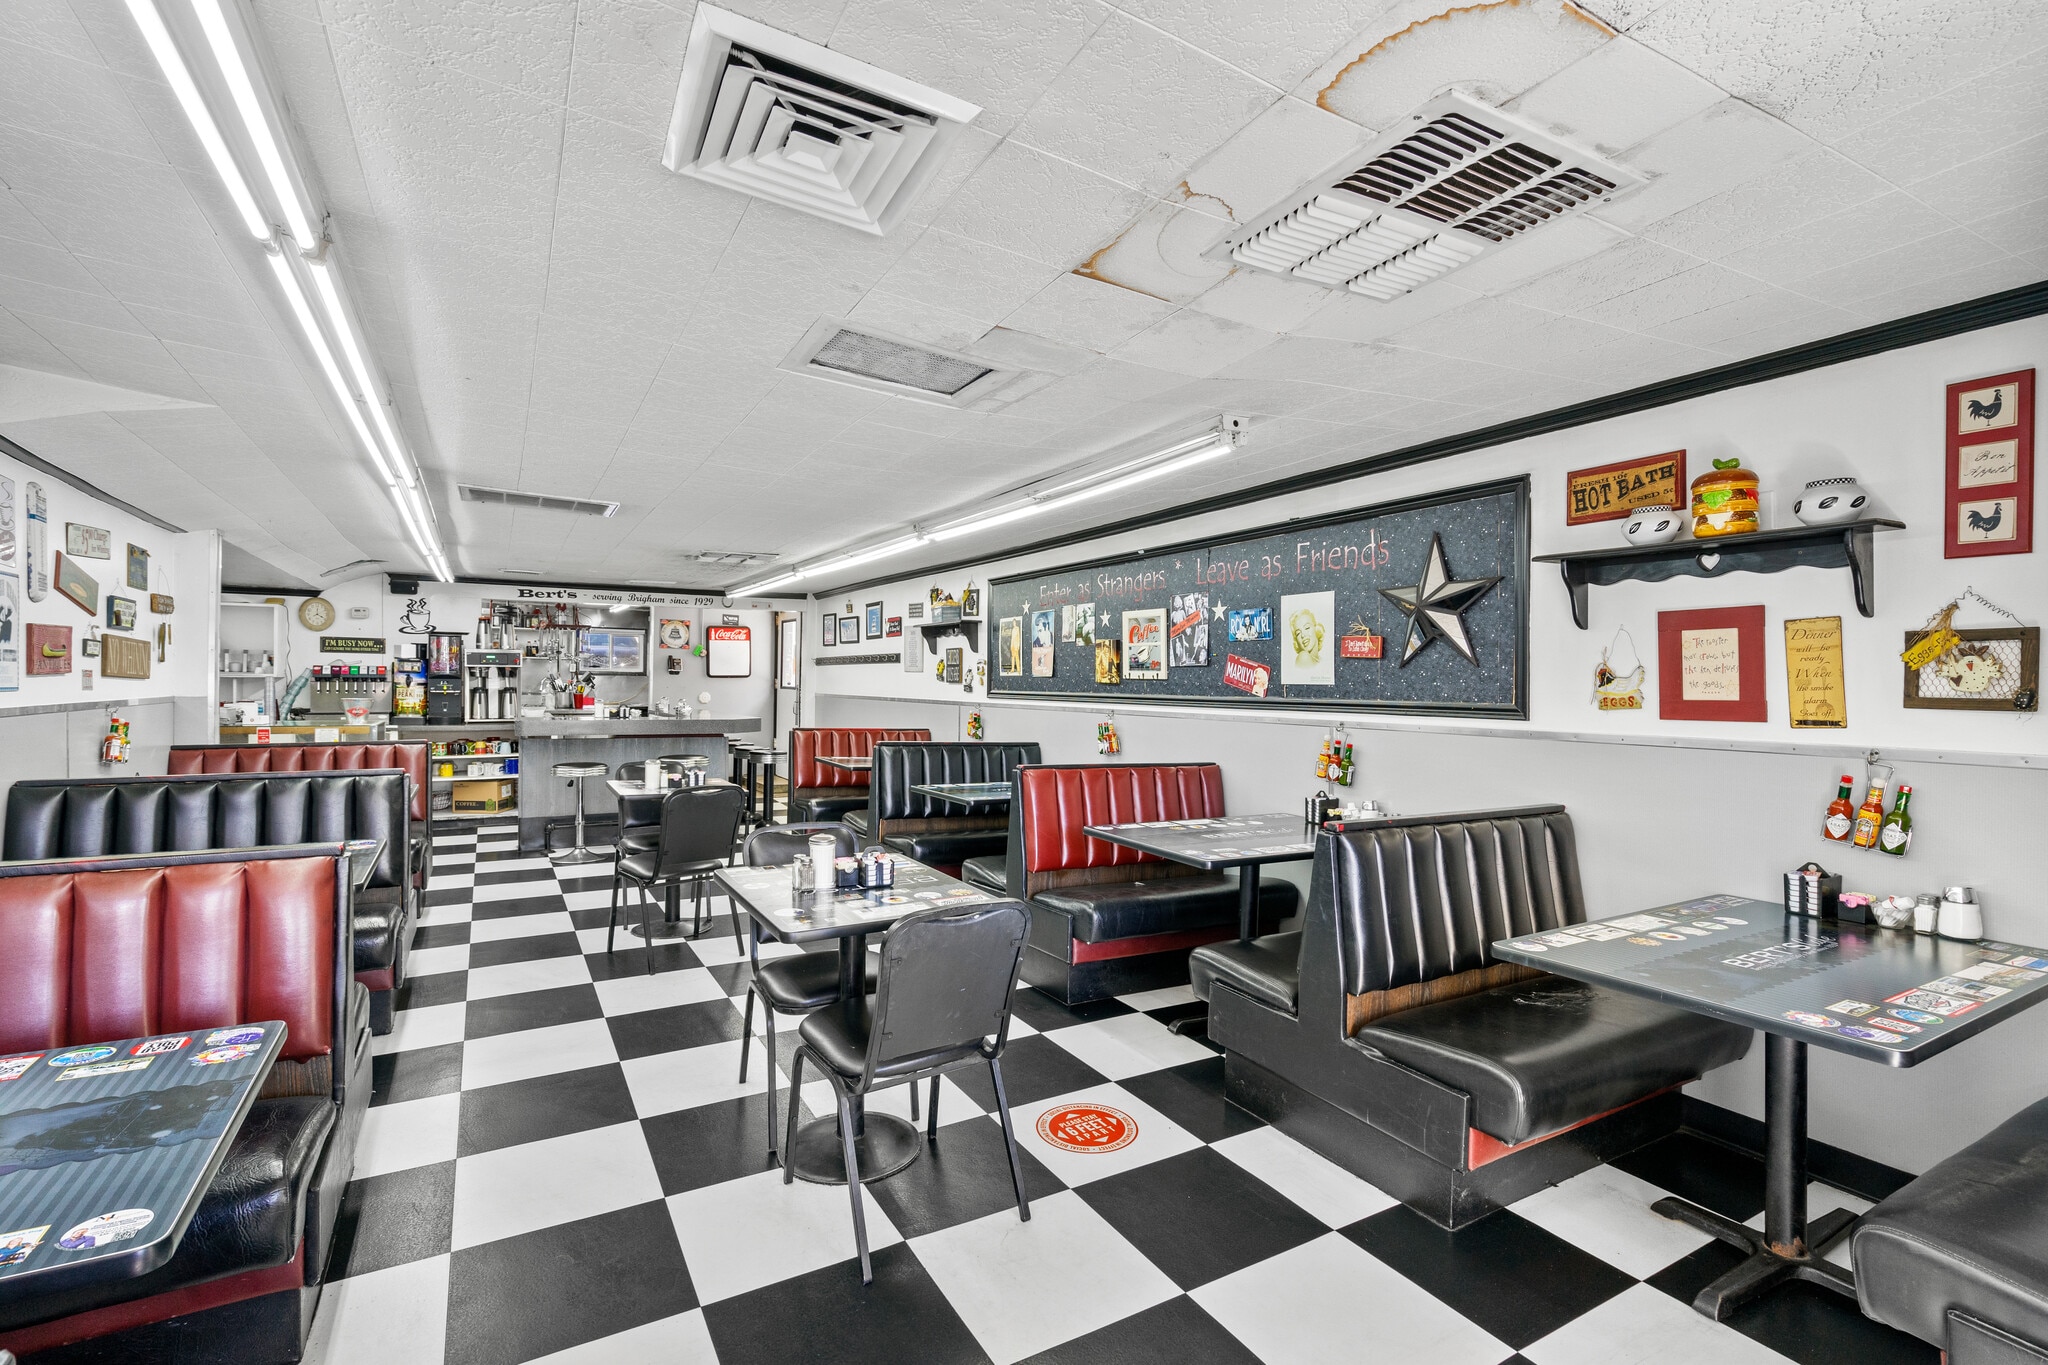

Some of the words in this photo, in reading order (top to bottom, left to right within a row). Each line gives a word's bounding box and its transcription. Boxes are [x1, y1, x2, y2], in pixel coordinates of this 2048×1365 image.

[1573, 477, 1609, 489] FRESH
[1573, 483, 1611, 513] HOT
[1616, 463, 1675, 500] BATH
[1629, 491, 1660, 503] USED
[1040, 583, 1071, 606] Enter
[1078, 582, 1090, 602] as
[1097, 571, 1166, 602] Strangers
[1196, 557, 1249, 586] Leave
[1261, 553, 1282, 580] as
[1296, 529, 1390, 573] Friends
[518, 589, 577, 599] Bert's
[592, 593, 622, 604] serving
[628, 593, 665, 604] Brigham
[669, 597, 689, 605] since
[694, 597, 713, 606] 1929
[1129, 623, 1160, 644] Coffee
[1791, 628, 1836, 640] Dinner
[1692, 637, 1704, 648] The
[1820, 643, 1830, 651] be
[1721, 650, 1735, 659] but
[1800, 654, 1825, 663] ready
[1226, 661, 1255, 686] MARILYN
[1796, 661, 1831, 678] When
[1810, 683, 1834, 691] smoke
[1602, 695, 1635, 708] EGGS
[1721, 942, 1811, 968] BERT'S
[1058, 1118, 1082, 1128] PLEASE
[1082, 1114, 1098, 1122] STAY
[1065, 1127, 1079, 1136] 6
[1075, 1118, 1108, 1133] FEET
[1076, 1126, 1116, 1142] APART
